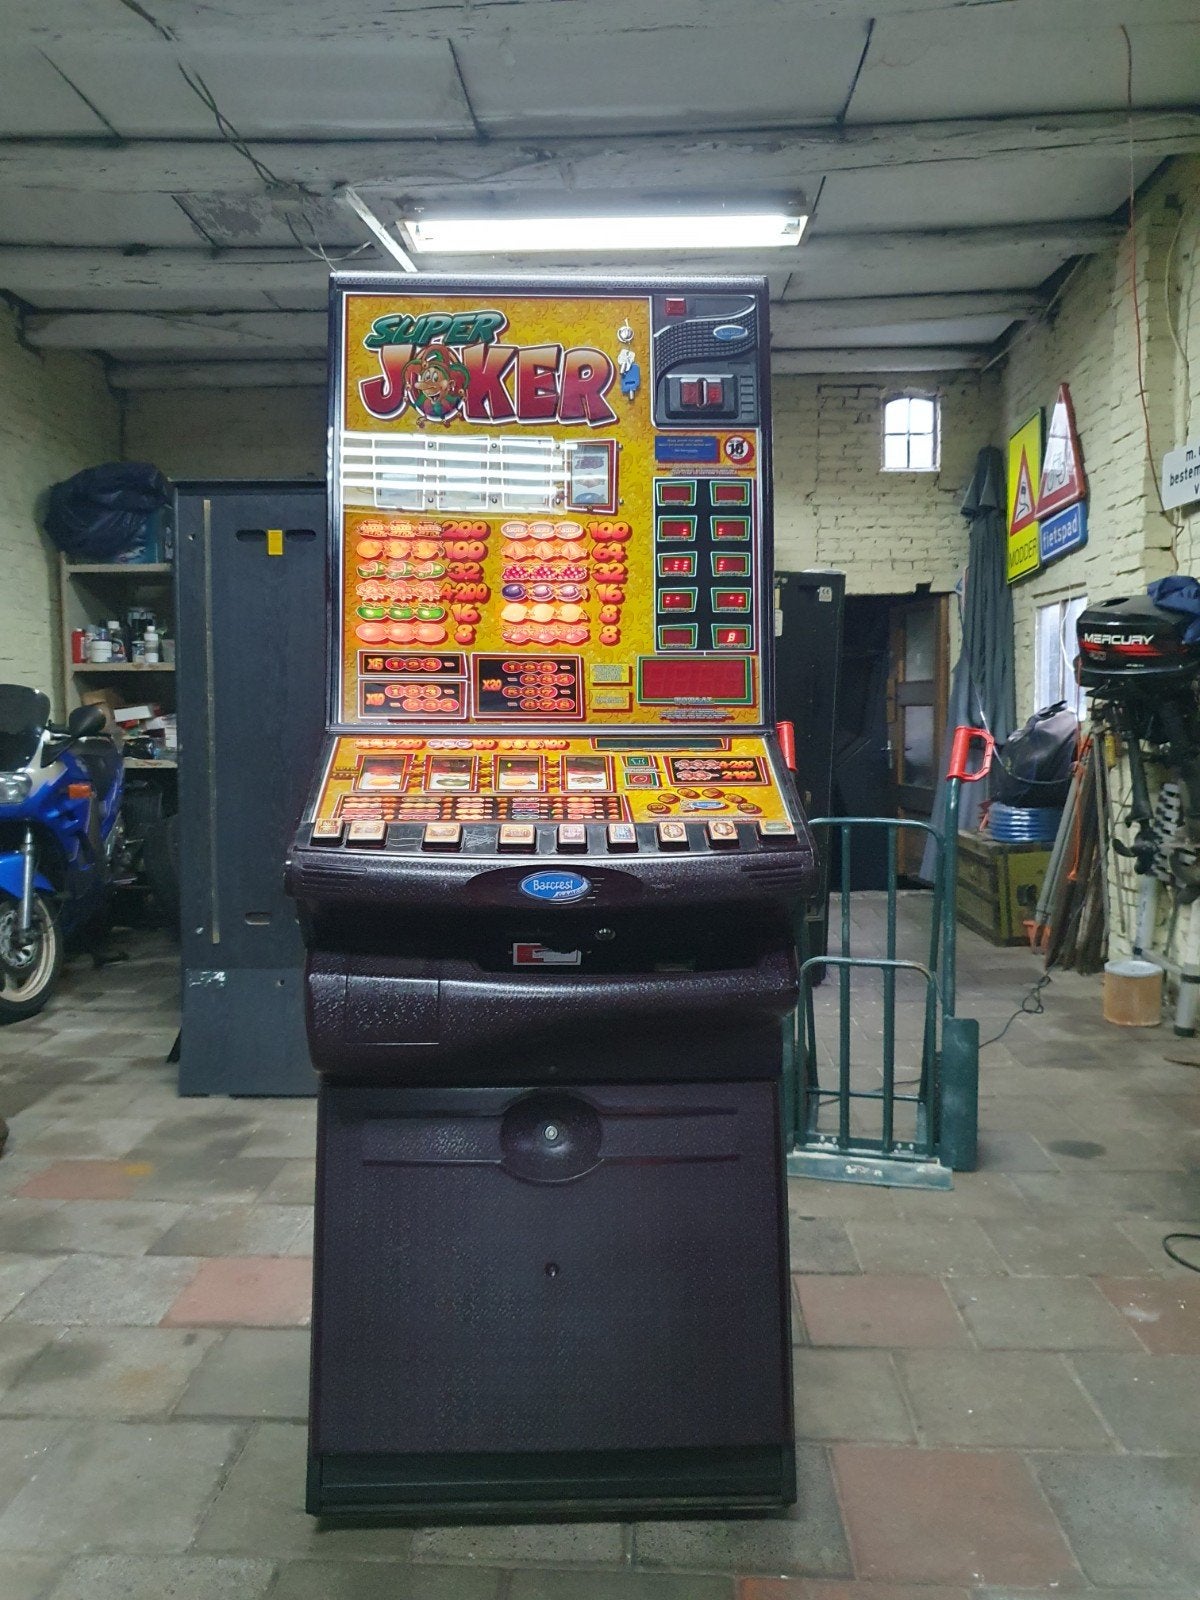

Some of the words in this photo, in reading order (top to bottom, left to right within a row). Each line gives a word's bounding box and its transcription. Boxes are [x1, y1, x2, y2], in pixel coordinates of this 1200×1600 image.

[363, 311, 506, 347] SUPER
[359, 343, 620, 426] JOKER
[728, 442, 745, 455] 18
[1186, 446, 1200, 461] m.
[442, 520, 488, 538] 200
[587, 521, 630, 540] 100
[1043, 513, 1078, 551] fietspad
[442, 541, 486, 560] 100
[592, 542, 626, 561] 64
[447, 562, 482, 580] 32
[592, 562, 626, 582] 32
[441, 582, 488, 601] 4-200
[595, 583, 624, 602] 16
[451, 603, 480, 622] 16
[600, 604, 618, 622] 8
[454, 624, 474, 643] 8
[600, 625, 618, 643] 8
[1084, 633, 1155, 645] MERCURY
[533, 880, 573, 891] Barcrest
